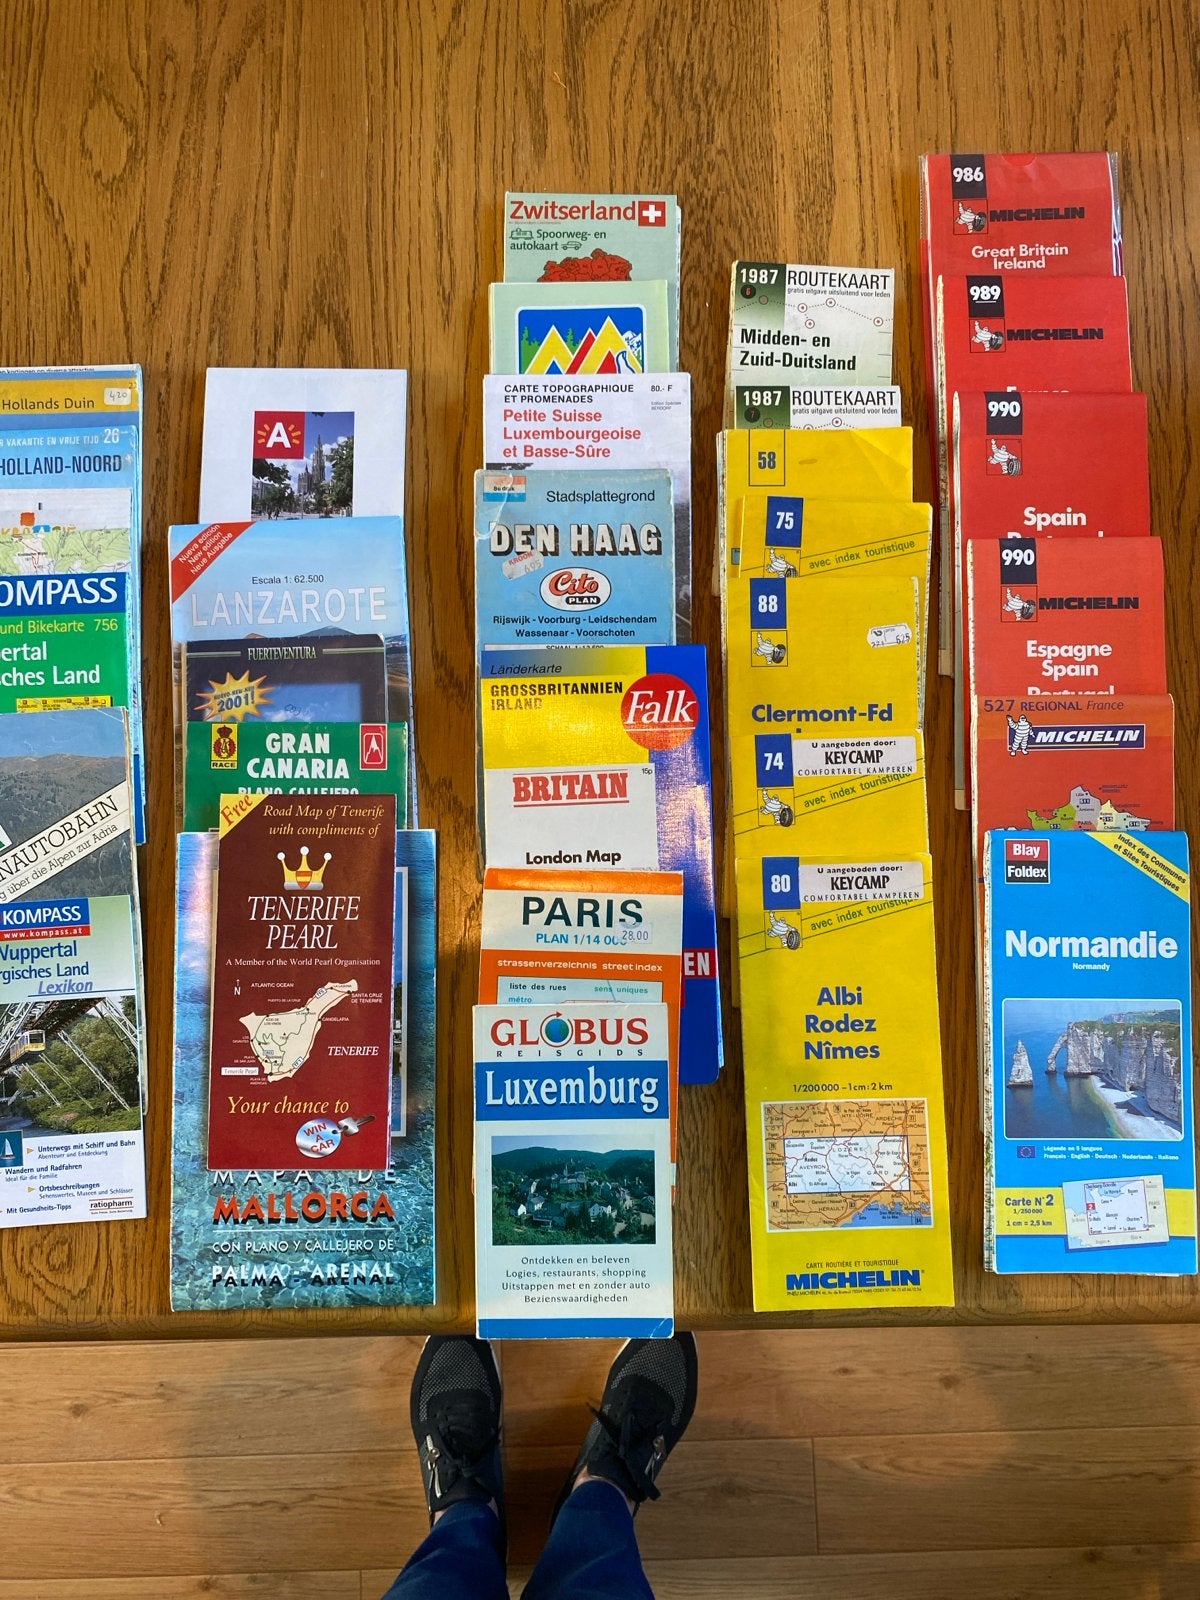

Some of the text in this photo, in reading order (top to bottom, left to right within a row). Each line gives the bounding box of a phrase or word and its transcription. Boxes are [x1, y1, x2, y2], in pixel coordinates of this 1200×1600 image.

[952, 167, 984, 182] 986
[509, 200, 636, 221] Zwitserland
[989, 206, 1085, 222] MICHELIN
[536, 228, 592, 242] Spoorweg-
[509, 241, 559, 250] autokaart
[971, 243, 1069, 258] Great Britain
[993, 256, 1046, 270] Ireland
[740, 268, 890, 291] 1987 ROUTEKAART
[969, 285, 1001, 302] 989
[740, 328, 831, 348] Midden- en
[1006, 328, 1104, 341] MICHELIN
[739, 350, 857, 371] Zuid-Duitsland
[503, 384, 635, 394] CARTE TOPOGRAPHIQUE
[2, 397, 95, 410] Hollands Duin
[504, 395, 594, 404] ET PROMENADES
[743, 390, 897, 407] 1987 ROUTEKAART
[503, 408, 603, 422] Petite Suisse
[988, 401, 1021, 417] 990
[6, 437, 45, 447] VAKANTIE
[46, 437, 57, 446] EN
[103, 428, 120, 444] 26
[503, 427, 641, 442] Luxembourgeoise
[502, 444, 611, 459] et Basse-Sûre
[757, 451, 776, 470] 58
[546, 490, 656, 505] Stadsplattegrond
[775, 511, 795, 530] 75
[1023, 507, 1087, 531] Spain
[489, 522, 663, 557] DEN HAAG
[808, 539, 916, 570] avec index touristique
[1001, 549, 1035, 566] 990
[251, 574, 324, 585] Escala 62.500
[548, 570, 600, 597] Cito
[190, 586, 388, 627] LANZAROTE
[568, 596, 598, 605] PLAN
[757, 594, 779, 613] 88
[1039, 597, 1139, 610] MICHELIN
[28, 619, 119, 634] Bikekarte 756
[492, 615, 657, 626] Rijswijk Voorburg Leidschendam
[515, 628, 636, 638] Wassenaar Voorschoten
[247, 646, 317, 661] FUERTEVENTURA
[1026, 640, 1113, 661] Espagne
[52, 664, 100, 685] Land
[490, 663, 562, 675] Länderkarte
[1041, 660, 1099, 681] Spain
[490, 681, 624, 697] GROSSBRITANNIEN
[217, 685, 255, 713] 2001!
[491, 698, 543, 711] IRLAND
[984, 700, 1124, 712] 527 REGIONAL France
[624, 688, 698, 727] Falk
[751, 703, 893, 723] Clermont-Fd
[265, 732, 330, 754] GRAN
[1035, 729, 1142, 743] MICHELIN
[763, 752, 784, 771] 74
[824, 749, 884, 765] KEYCAMP
[246, 758, 350, 779] CANARIA
[512, 772, 629, 802] BRITAIN
[219, 794, 254, 828] Free
[263, 804, 385, 820] Road Map Tenerife
[269, 823, 366, 839] with compliments
[7, 823, 119, 894] über Alpen zur Adria
[525, 849, 622, 866] London Map
[1012, 842, 1041, 859] Blay
[1117, 834, 1187, 885] Index Communes
[1007, 865, 1047, 879] Foldex
[1140, 856, 1181, 893] Touristiques
[770, 874, 791, 893] 80
[830, 875, 890, 891] KEYCAMP
[2, 906, 82, 926] KOMPASS
[247, 895, 361, 922] TENERIFE
[522, 896, 644, 929] PARIS
[265, 924, 339, 950] PEARL
[536, 933, 601, 946] PLAN 1/14
[621, 930, 649, 941] 28.00
[1005, 929, 1179, 960] Normandie
[56, 961, 89, 977] Land
[234, 957, 381, 969] Member the World Pearl Organisation
[497, 959, 664, 972] strassenverzeichnis street index
[1072, 962, 1111, 972] Normandy
[38, 979, 94, 995] Lexikon
[509, 982, 527, 991] liste
[594, 985, 613, 993] sens
[616, 986, 649, 995] uniques
[507, 995, 533, 1004] métro
[817, 986, 864, 1006] Albi
[805, 1013, 877, 1033] Rodez
[327, 1045, 379, 1056] TENERIFE
[804, 1041, 880, 1060] Nîmes
[485, 1065, 659, 1114] Luxemburg
[228, 1096, 350, 1114] Your chance to
[303, 1121, 328, 1138] WIN
[38, 1144, 71, 1153] Unterwegs
[72, 1143, 84, 1151] mit
[85, 1142, 105, 1150] Schiff
[309, 1138, 336, 1154] CAR
[5, 1163, 83, 1175] Wandern Radfahren
[19, 1204, 72, 1214] Gesundheits-Tipps
[90, 1199, 133, 1211] ratiopharm
[212, 1191, 395, 1225] MALLORCA
[1004, 1197, 1033, 1206] Carte
[521, 1255, 630, 1265] Ontdekken beleven
[825, 1260, 853, 1269] ROUTIÈRE
[862, 1259, 900, 1267] TOURISTIQUE
[212, 1263, 395, 1284] PALMA ARENAL
[505, 1268, 647, 1279] Logies, shopping
[786, 1270, 921, 1290] MICHELIN
[501, 1281, 651, 1292] Uitstappen met zonder auto
[524, 1294, 629, 1304] Bezienswaardigheden
